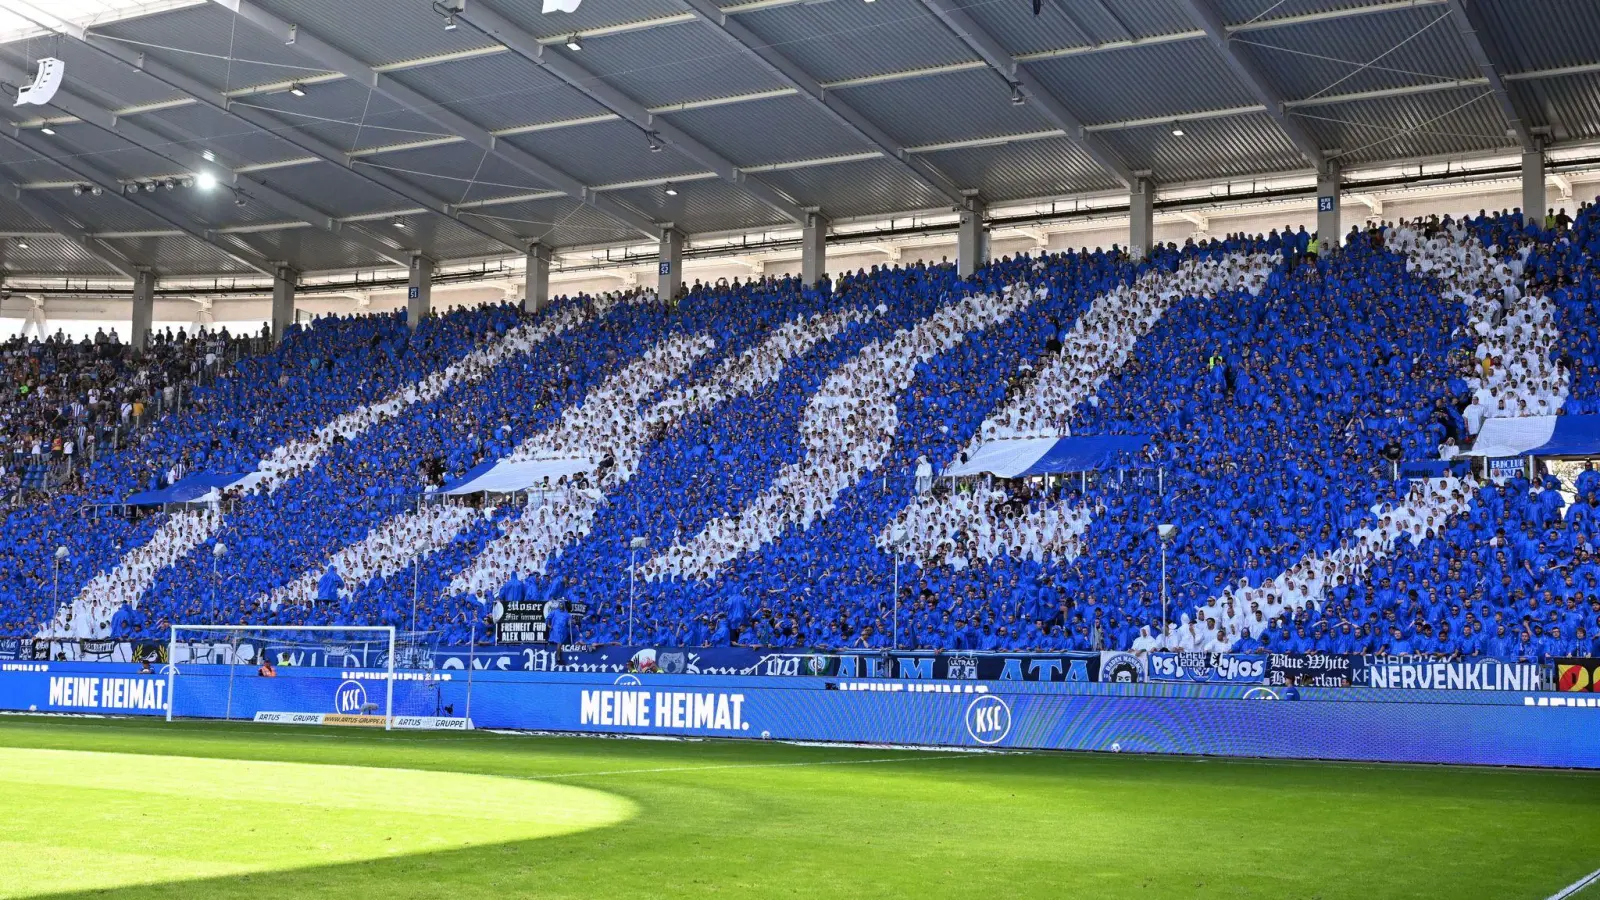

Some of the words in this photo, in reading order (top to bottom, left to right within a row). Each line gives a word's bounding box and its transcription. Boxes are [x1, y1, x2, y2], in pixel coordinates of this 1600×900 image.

[507, 601, 543, 611] Moser
[501, 622, 531, 632] FREIHEIT
[501, 632, 519, 642] ALEX
[520, 632, 535, 641] UND
[536, 632, 546, 641] M.
[1270, 653, 1350, 671] Blue-White
[1370, 663, 1541, 690] NERVENKLINIK
[49, 676, 100, 707] MEINE
[101, 678, 168, 710] HEIMAT.
[342, 689, 361, 712] KSC
[258, 712, 281, 722] ARTUS
[292, 714, 320, 722] GRUPPE
[580, 690, 651, 727] MEINE
[655, 692, 750, 731] HEIMAT.
[976, 705, 1002, 732] KSC
[398, 718, 421, 726] ARTUS
[435, 719, 465, 728] GRUPPE
